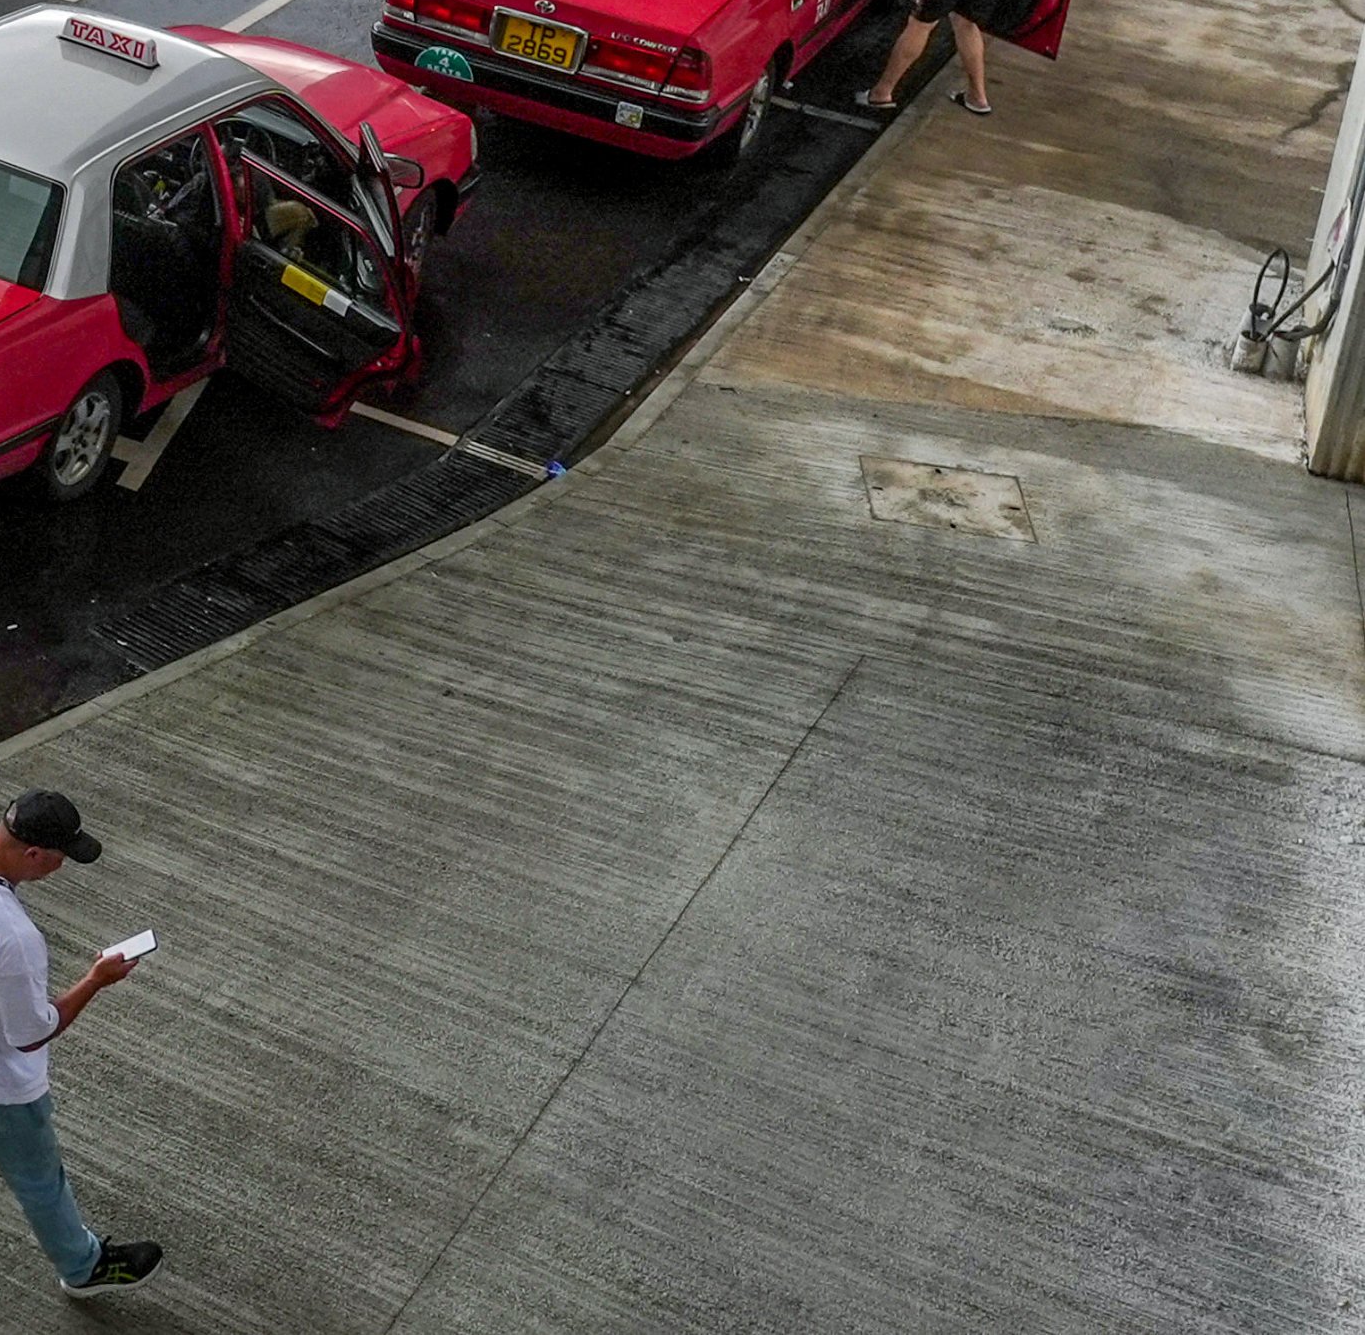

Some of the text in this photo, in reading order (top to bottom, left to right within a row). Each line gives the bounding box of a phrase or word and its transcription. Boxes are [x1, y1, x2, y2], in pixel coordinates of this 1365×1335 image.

[72, 20, 145, 57] TAXI
[527, 22, 554, 40] TP
[433, 45, 458, 57] TAXI
[506, 35, 567, 65] 2869
[438, 56, 450, 67] 4
[425, 64, 462, 78] SEATS
